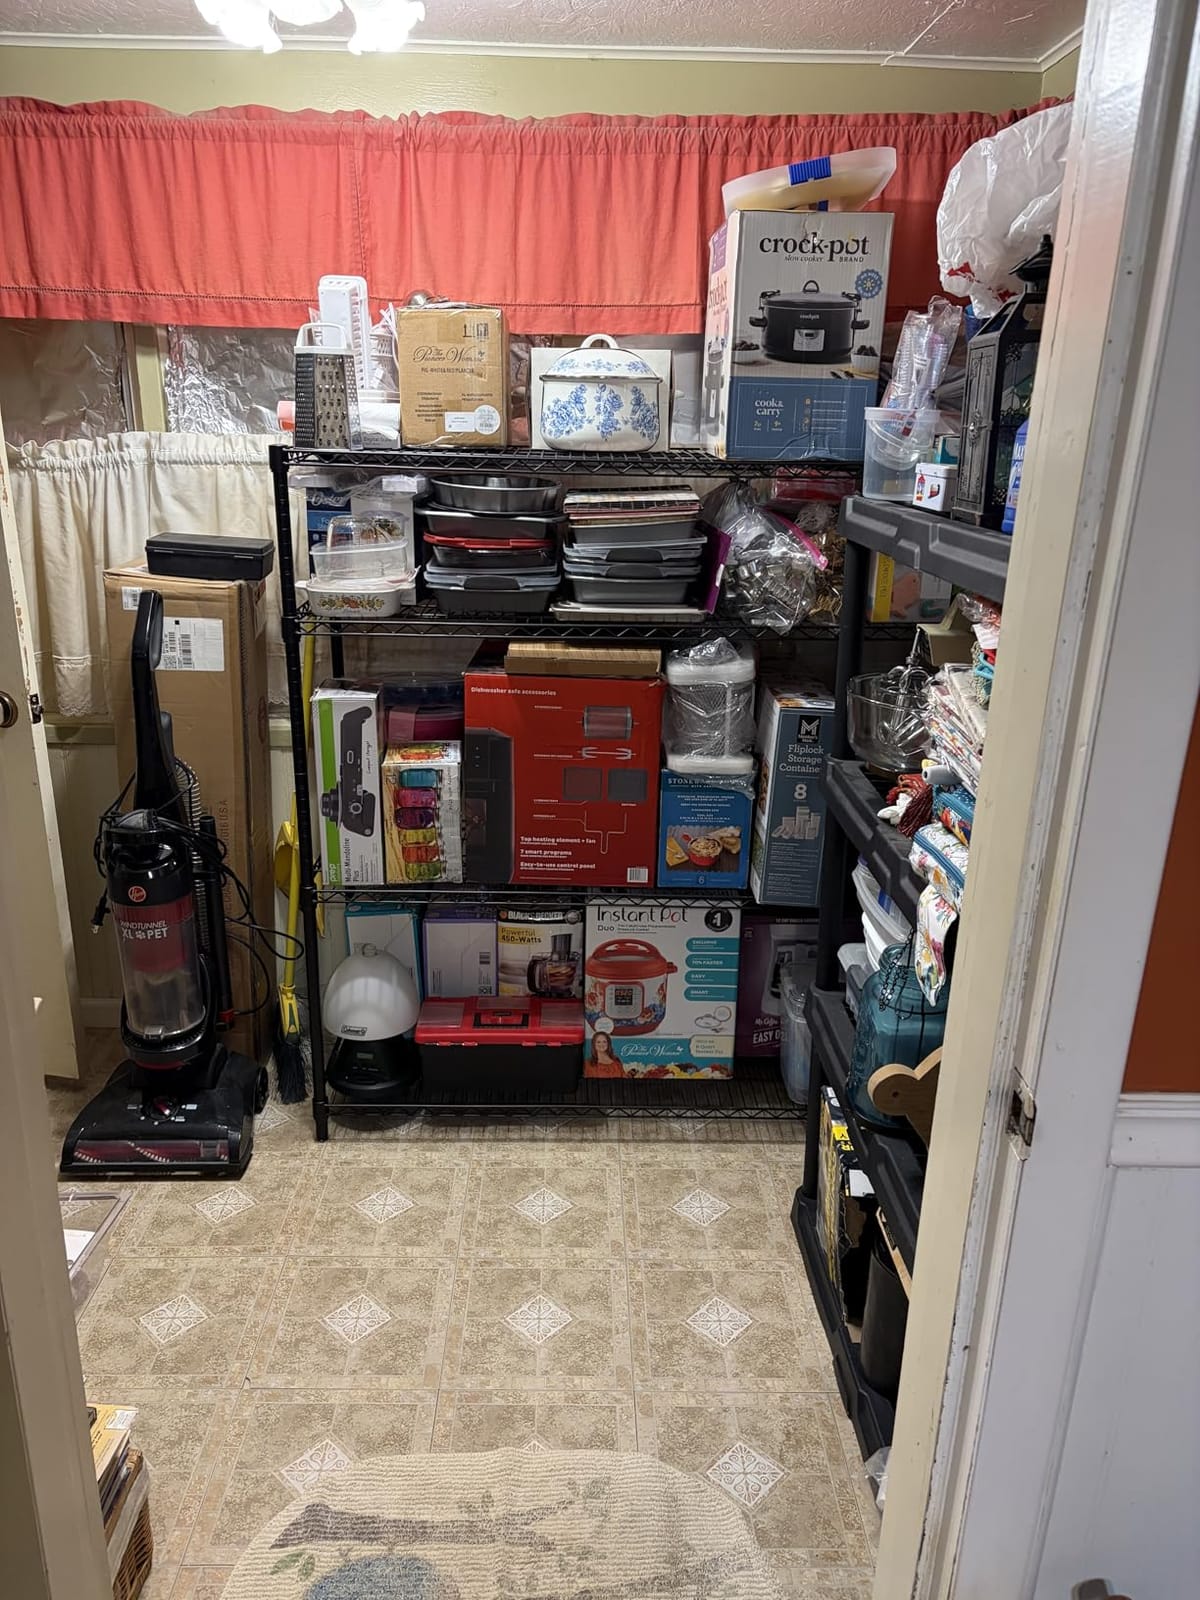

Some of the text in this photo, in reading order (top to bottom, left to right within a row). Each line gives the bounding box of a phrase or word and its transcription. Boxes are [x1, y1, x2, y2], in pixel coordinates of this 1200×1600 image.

[759, 231, 871, 262] crock-pot
[756, 408, 780, 418] carry
[788, 744, 825, 755] Fliplock
[787, 754, 823, 765] Storage
[793, 783, 807, 800] 8
[597, 905, 688, 923] Instant Pot
[146, 927, 168, 940] PET
[501, 927, 536, 937] Powerful
[752, 1030, 774, 1044] EASY
